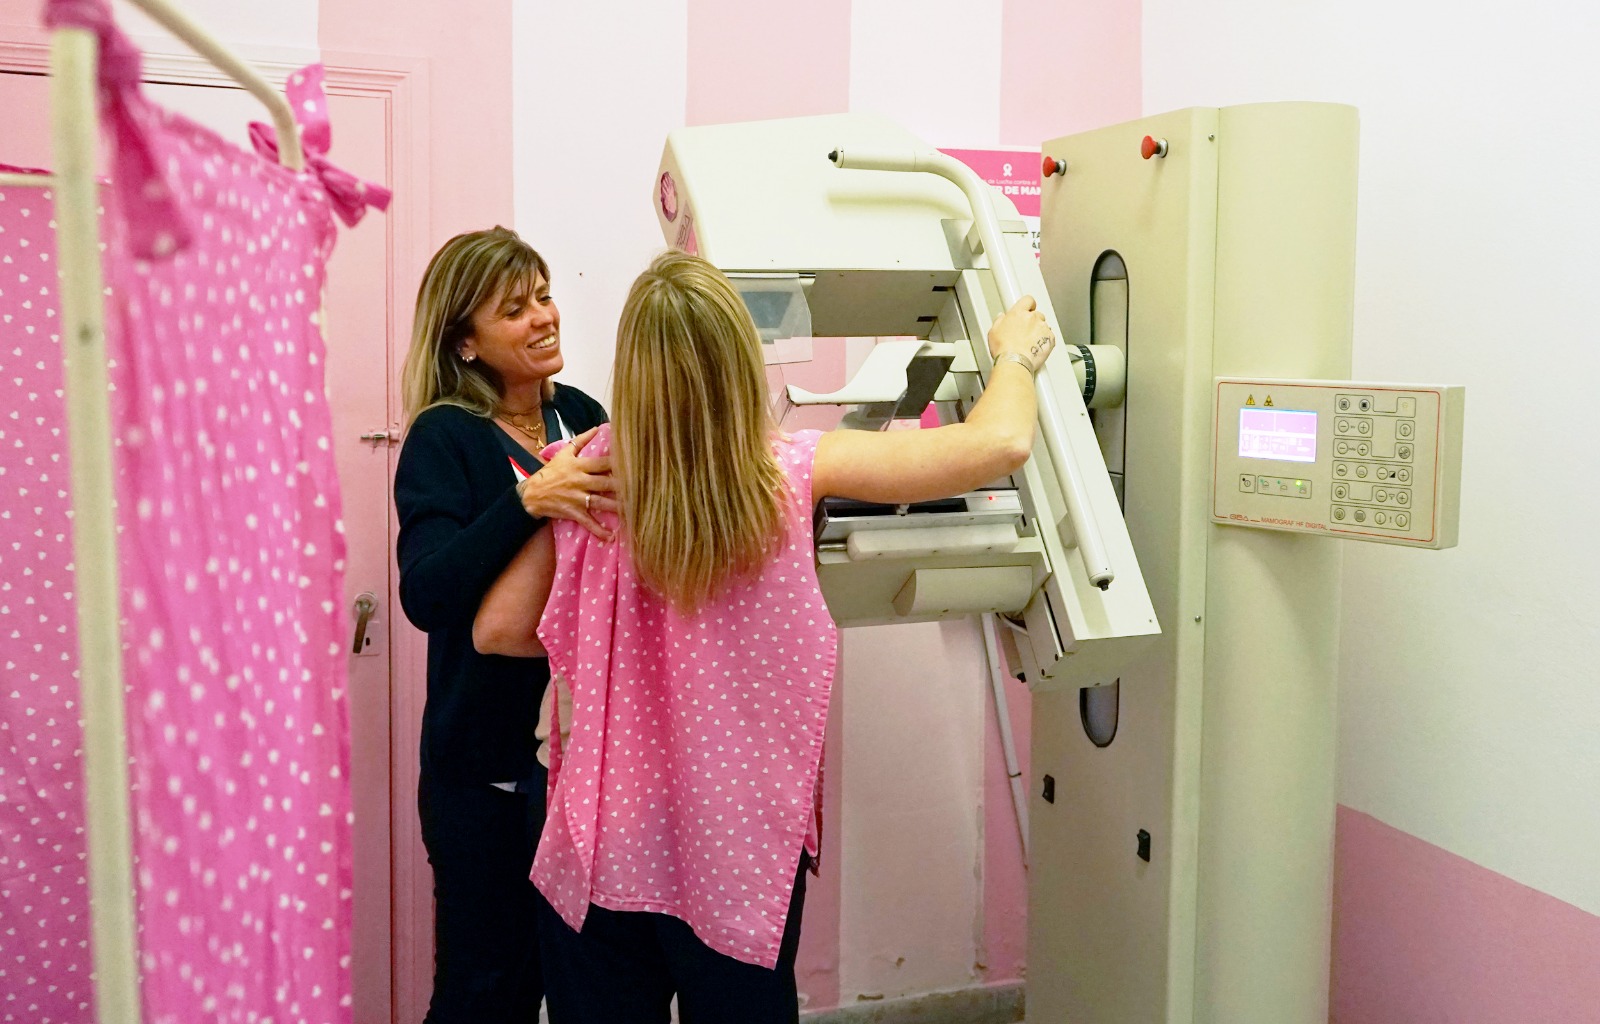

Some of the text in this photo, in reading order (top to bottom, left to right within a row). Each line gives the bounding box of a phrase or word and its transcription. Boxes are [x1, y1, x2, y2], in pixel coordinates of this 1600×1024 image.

[1004, 186, 1020, 194] DE
[1260, 517, 1294, 526] MAMOGRAF
[1305, 521, 1328, 530] DIGITAL
